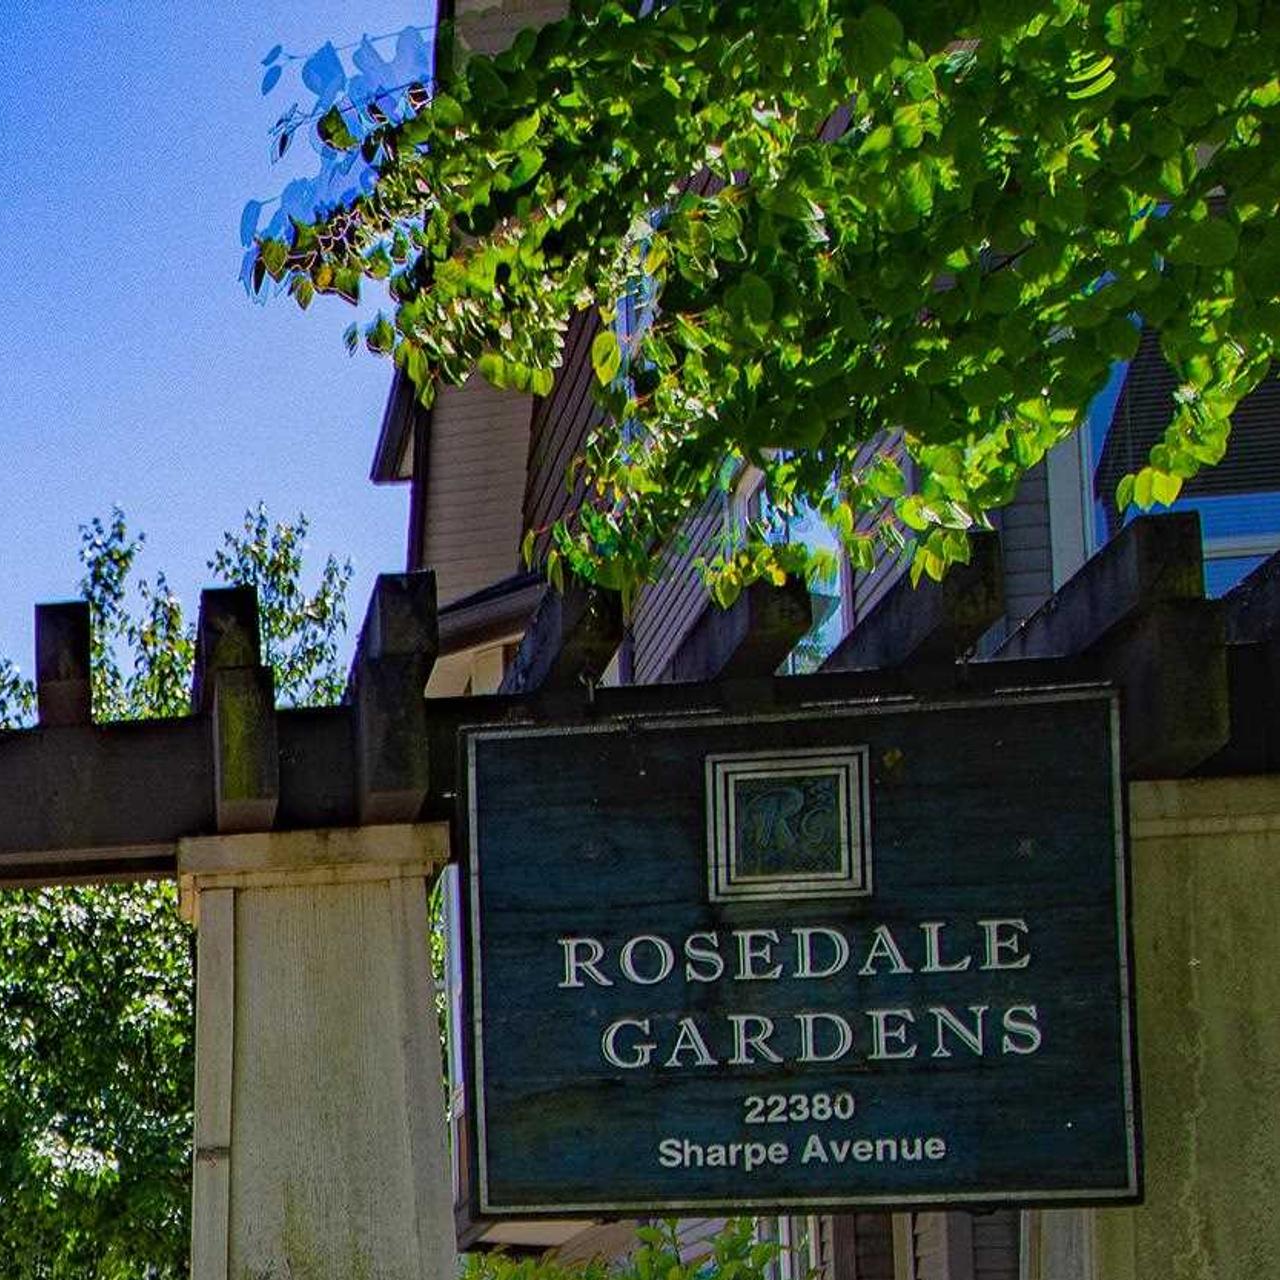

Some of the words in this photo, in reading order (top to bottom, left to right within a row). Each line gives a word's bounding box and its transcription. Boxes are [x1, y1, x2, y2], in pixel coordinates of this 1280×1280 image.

[557, 919, 1032, 989] ROSEDALE
[601, 1005, 1043, 1069] GARDENS
[743, 1093, 856, 1124] 22380
[658, 1137, 789, 1172] Sharpe
[800, 1134, 947, 1164] Avenue
